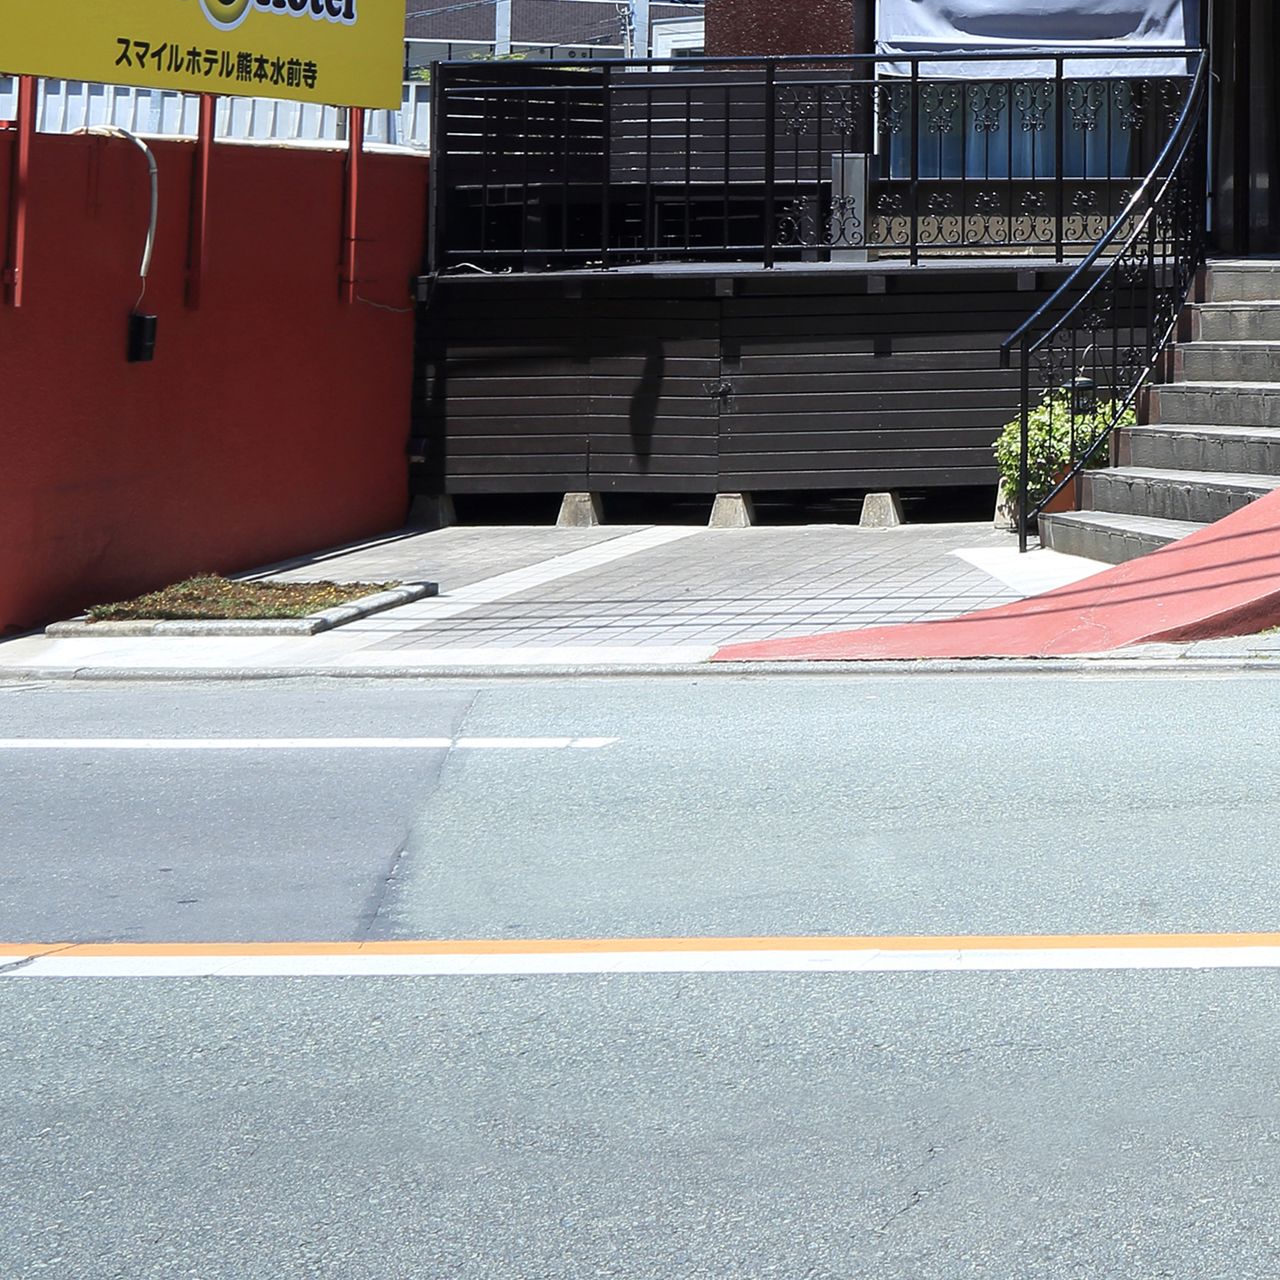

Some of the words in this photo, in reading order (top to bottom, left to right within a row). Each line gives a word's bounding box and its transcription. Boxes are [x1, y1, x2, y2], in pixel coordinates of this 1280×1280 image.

[115, 37, 318, 90] スマイルホテル熊本水前寺
